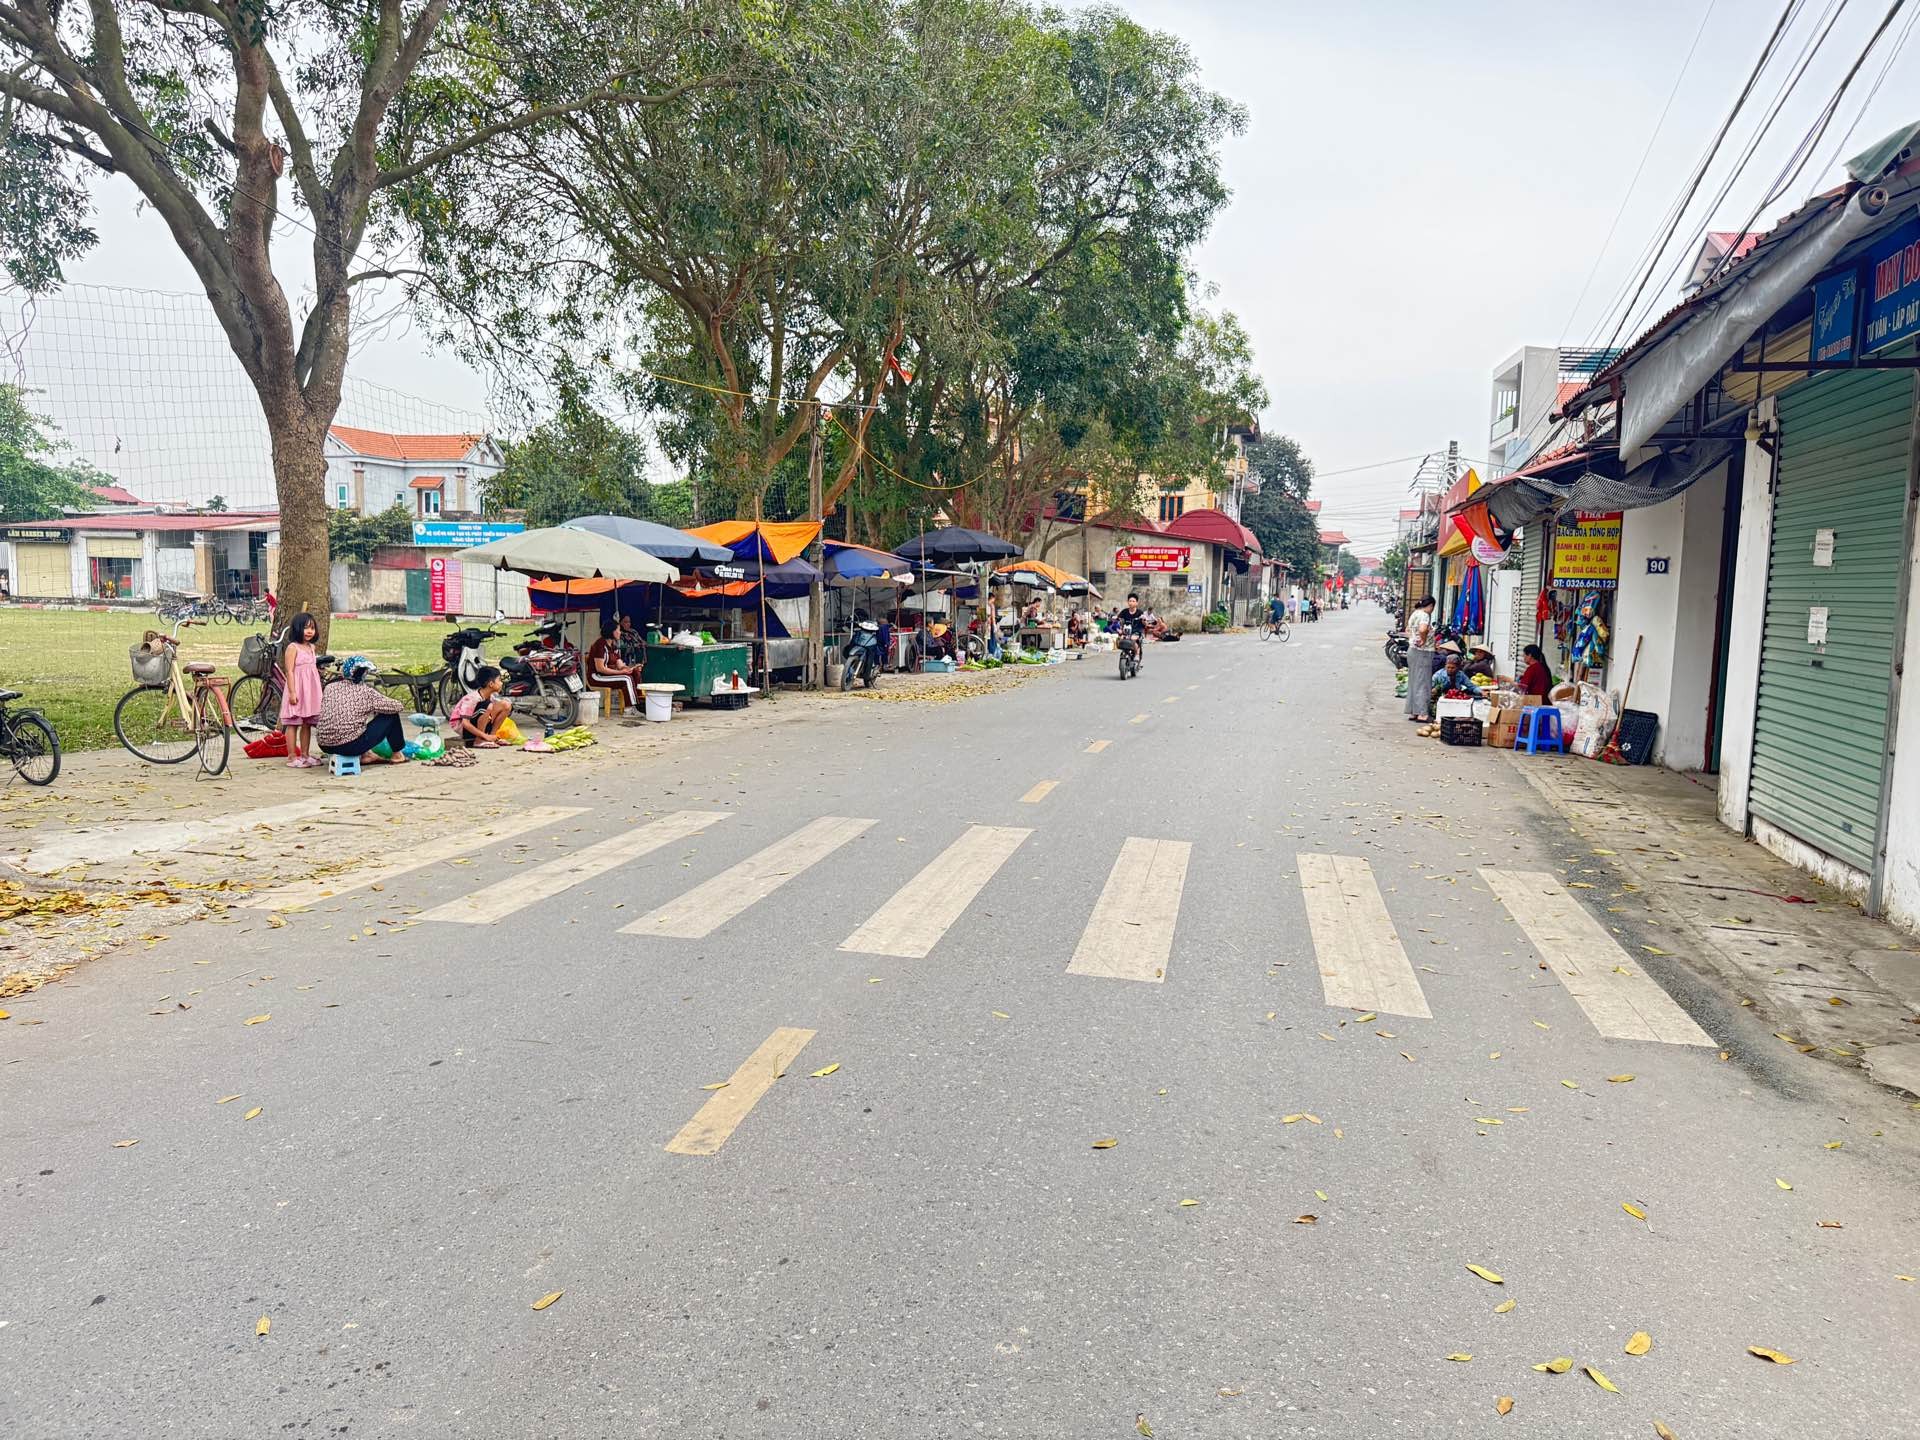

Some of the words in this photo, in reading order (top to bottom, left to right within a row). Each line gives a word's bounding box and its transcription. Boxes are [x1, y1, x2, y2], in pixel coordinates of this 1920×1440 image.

[1875, 249, 1903, 302] MAY
[1589, 522, 1605, 537] TỔNG
[1650, 560, 1666, 572] 90
[1566, 579, 1617, 588] 0326.643.123
